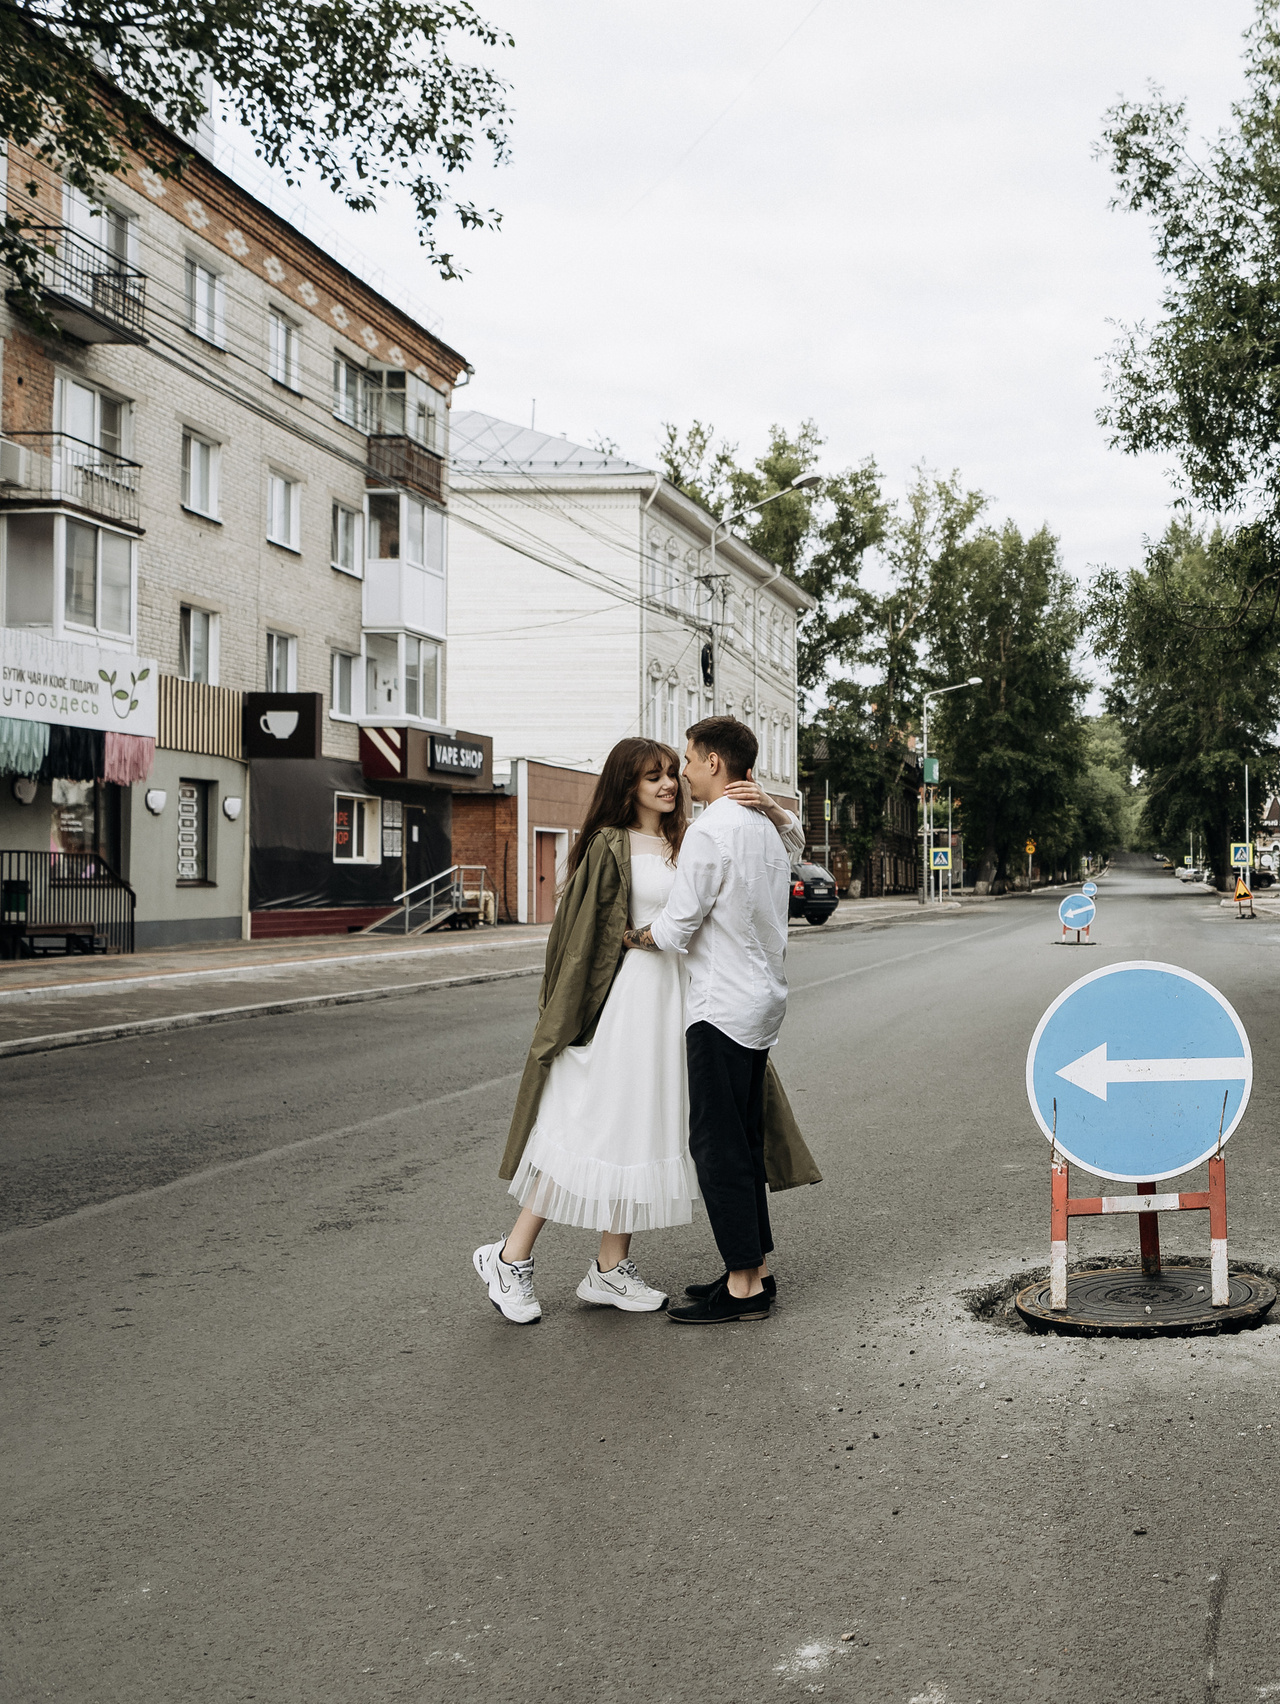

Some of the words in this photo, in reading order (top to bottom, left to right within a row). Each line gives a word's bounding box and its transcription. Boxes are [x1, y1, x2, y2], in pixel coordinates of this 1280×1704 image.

[3, 666, 25, 683] БУТИК
[27, 670, 42, 686] ЧАЯ
[43, 673, 48, 687] И
[70, 678, 99, 695] ПОДАРКИ
[435, 744, 459, 766] VAPE
[459, 748, 483, 769] SHOP
